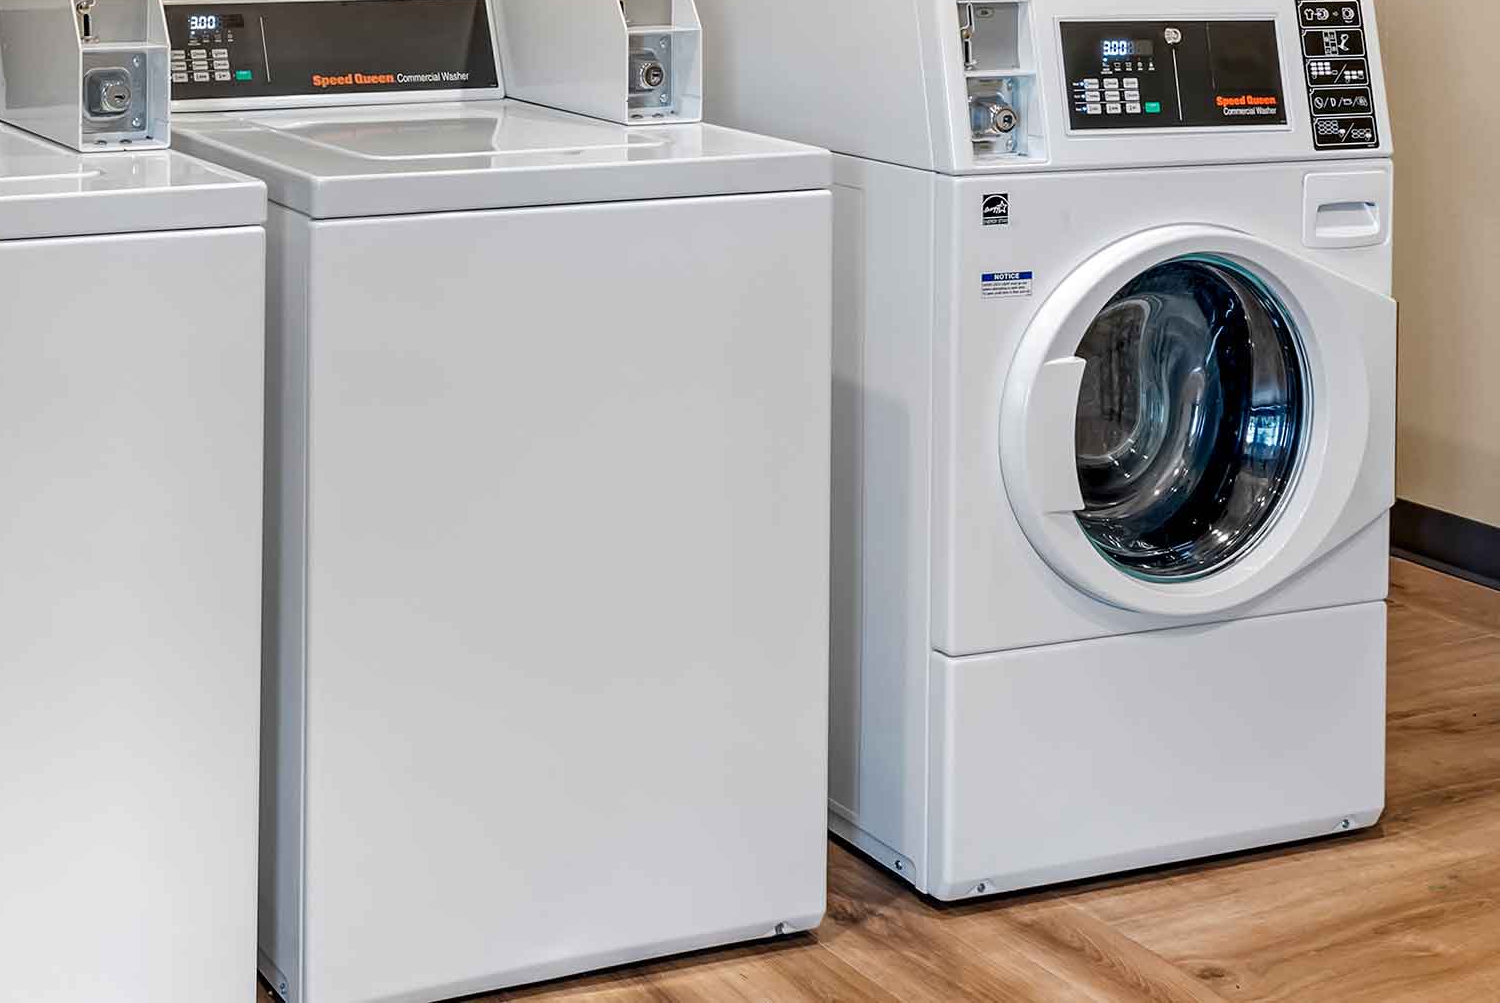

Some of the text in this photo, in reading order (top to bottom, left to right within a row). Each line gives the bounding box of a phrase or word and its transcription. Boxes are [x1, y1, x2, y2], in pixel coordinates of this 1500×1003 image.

[190, 15, 216, 30] 3.00
[312, 71, 469, 88] Speed Queen Commercial Washer
[1216, 95, 1277, 108] Speed Queen
[1223, 107, 1256, 116] Commercial
[994, 272, 1020, 280] NOTICE
